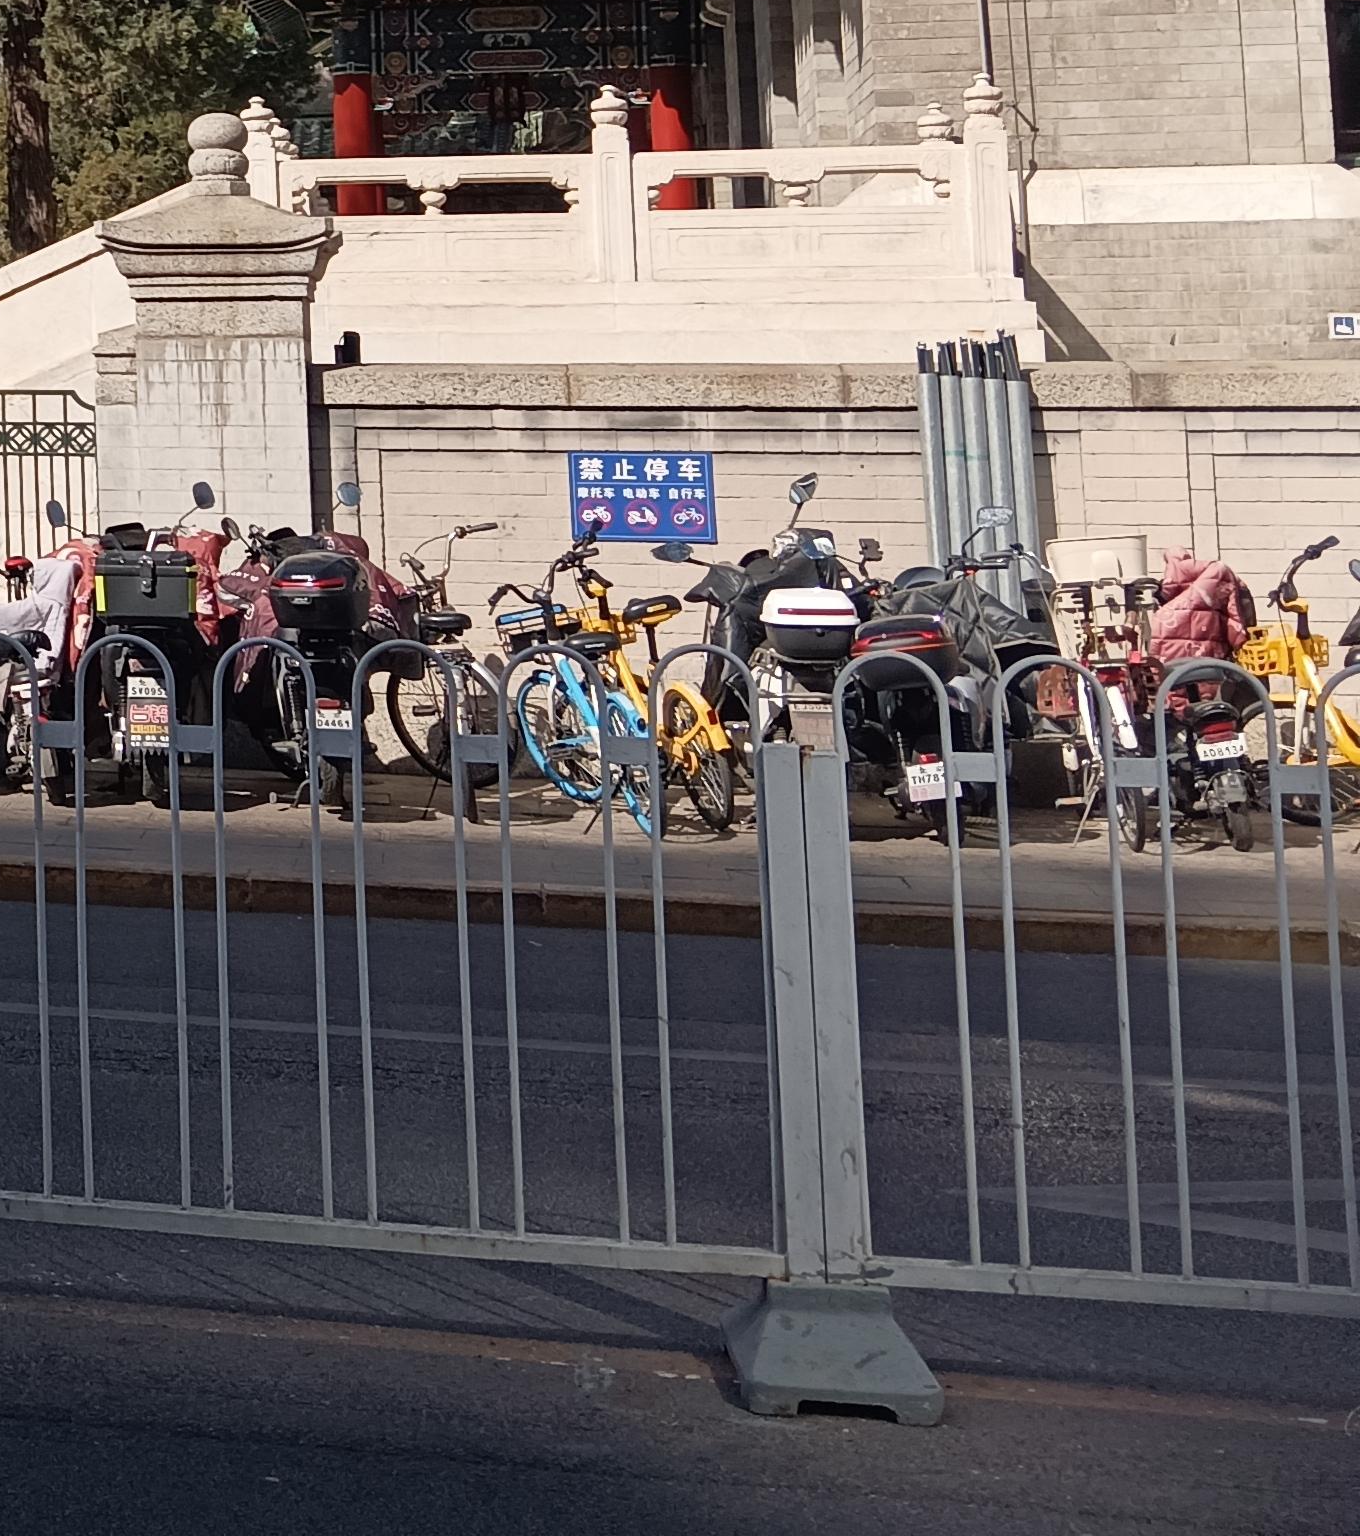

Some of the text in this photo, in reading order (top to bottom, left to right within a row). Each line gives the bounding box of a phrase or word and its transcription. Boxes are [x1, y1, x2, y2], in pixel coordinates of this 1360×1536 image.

[578, 457, 703, 482] 禁止停车
[577, 487, 708, 500] 摩托车 电动车 自行车
